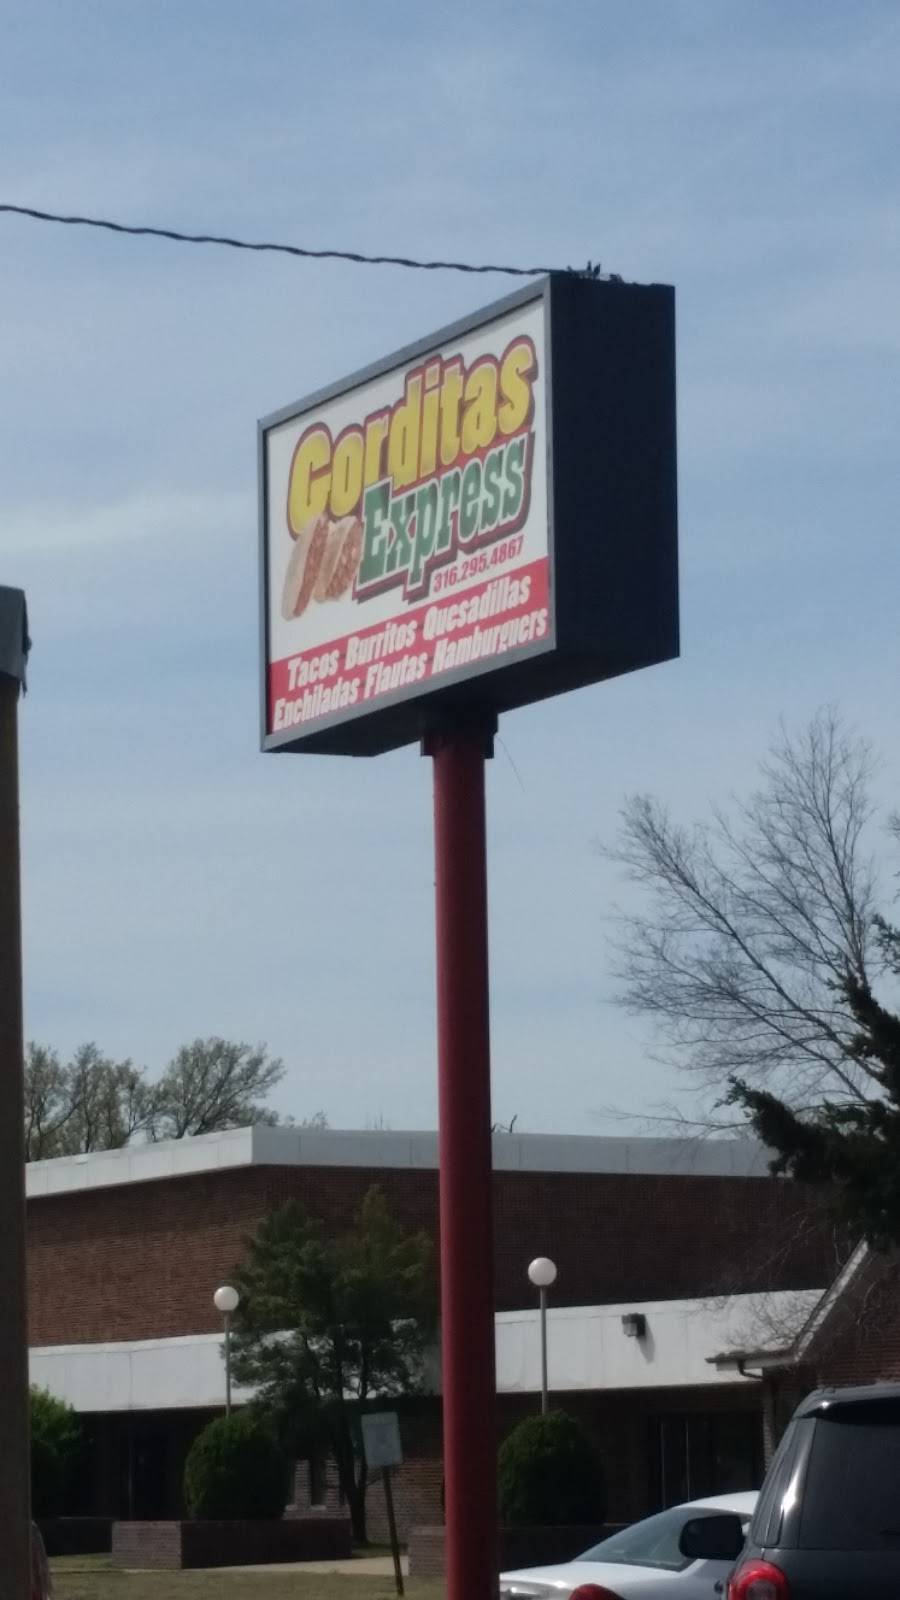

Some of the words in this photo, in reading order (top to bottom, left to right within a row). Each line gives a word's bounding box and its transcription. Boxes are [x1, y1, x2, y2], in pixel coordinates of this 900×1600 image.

[287, 335, 538, 541] Gorditas
[353, 432, 535, 604] Express
[434, 538, 524, 593] 316.295.4867
[288, 650, 340, 690] Tacos
[344, 621, 417, 671] Burritos
[422, 576, 531, 640] Quesadillas
[273, 678, 361, 732] Enchiladas
[363, 653, 427, 700] Flautas
